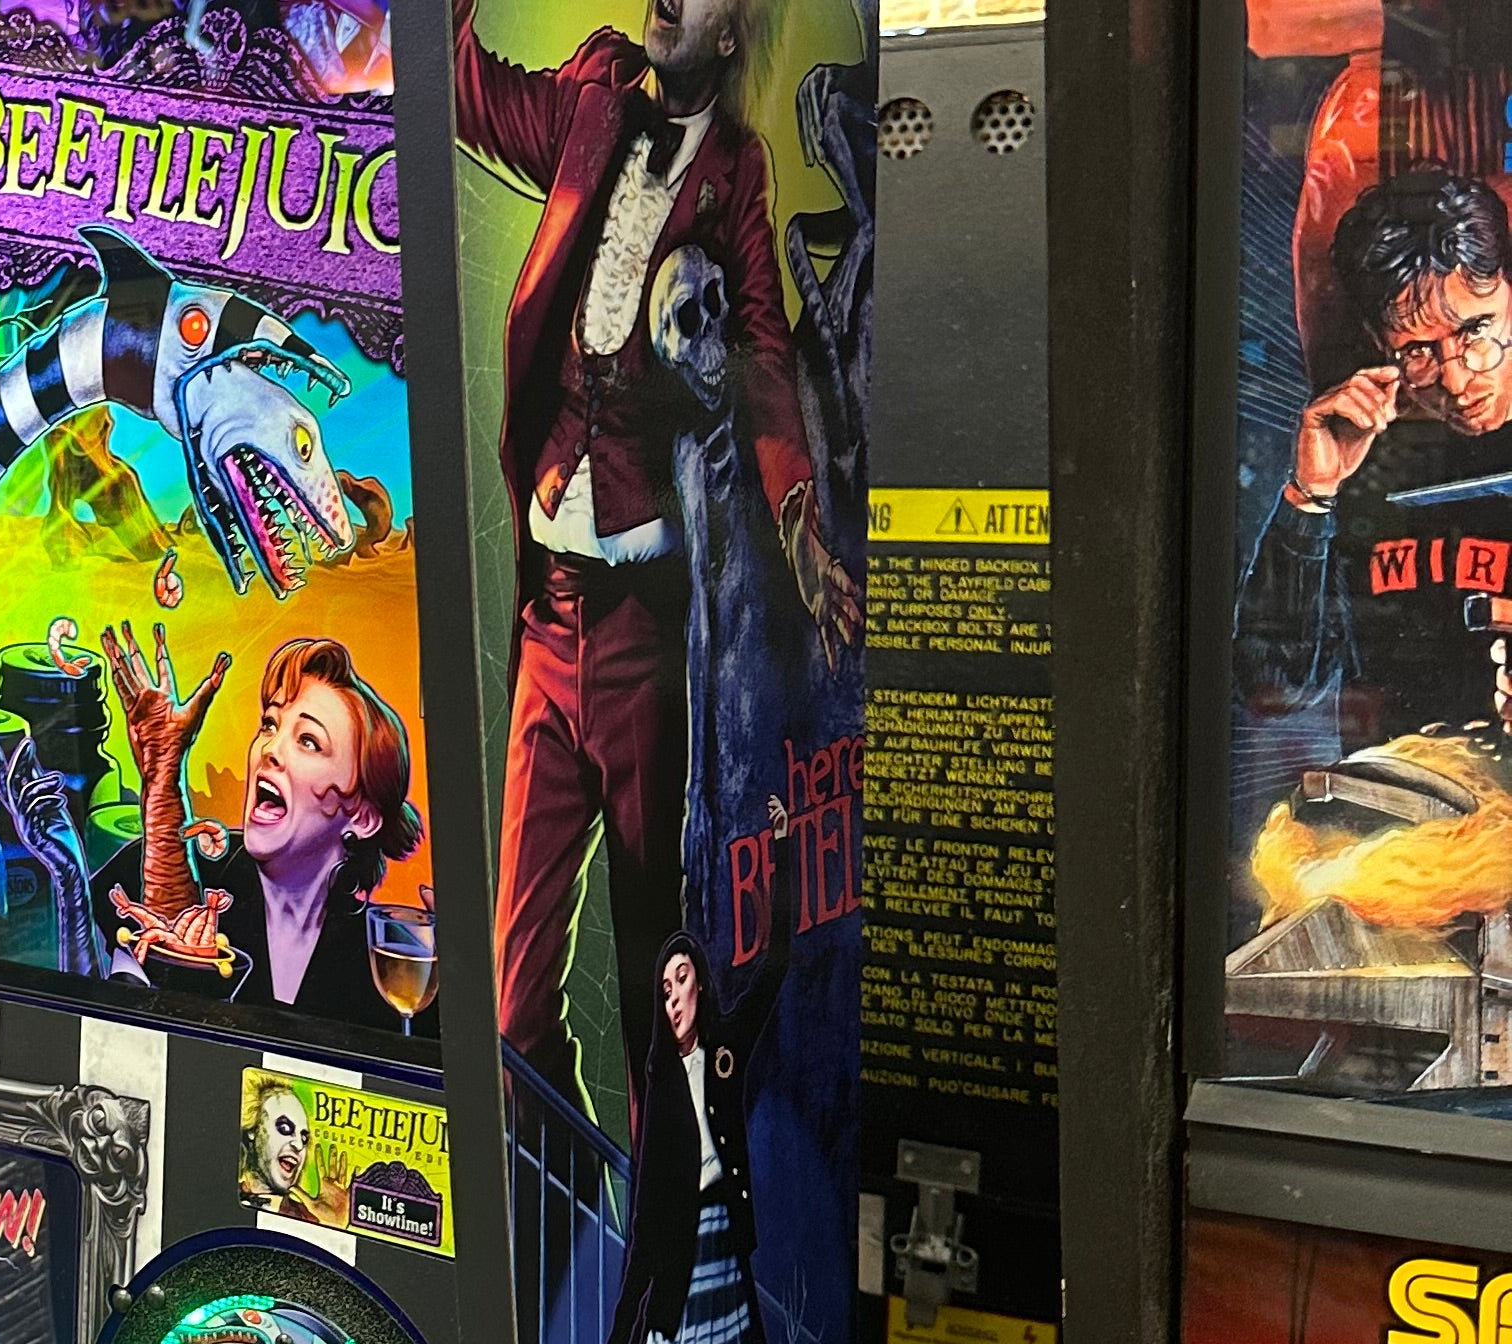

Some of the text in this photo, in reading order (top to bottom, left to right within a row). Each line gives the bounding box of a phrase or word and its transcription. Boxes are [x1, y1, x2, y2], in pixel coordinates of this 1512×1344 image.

[888, 557, 1038, 574] THE HINGED BACKBOX
[908, 574, 1014, 590] THE PLAYFIELD
[913, 588, 933, 600] OR
[891, 602, 961, 618] PURPOSES
[887, 618, 1037, 636] BACKBOX BOLTS ARE
[929, 636, 1002, 652] PERSONAL
[874, 689, 957, 705] STEHENDEM
[863, 835, 999, 858] AVEC LE FRONTON
[1004, 864, 1031, 876] JEU
[975, 890, 1043, 907] PENDANT
[985, 907, 1023, 923] FAUT
[901, 971, 920, 984] LA
[930, 973, 994, 992] TESTATA
[314, 1128, 402, 1156] COLLECTORS
[382, 1195, 404, 1214] It's
[357, 1205, 433, 1236] Showtime!
